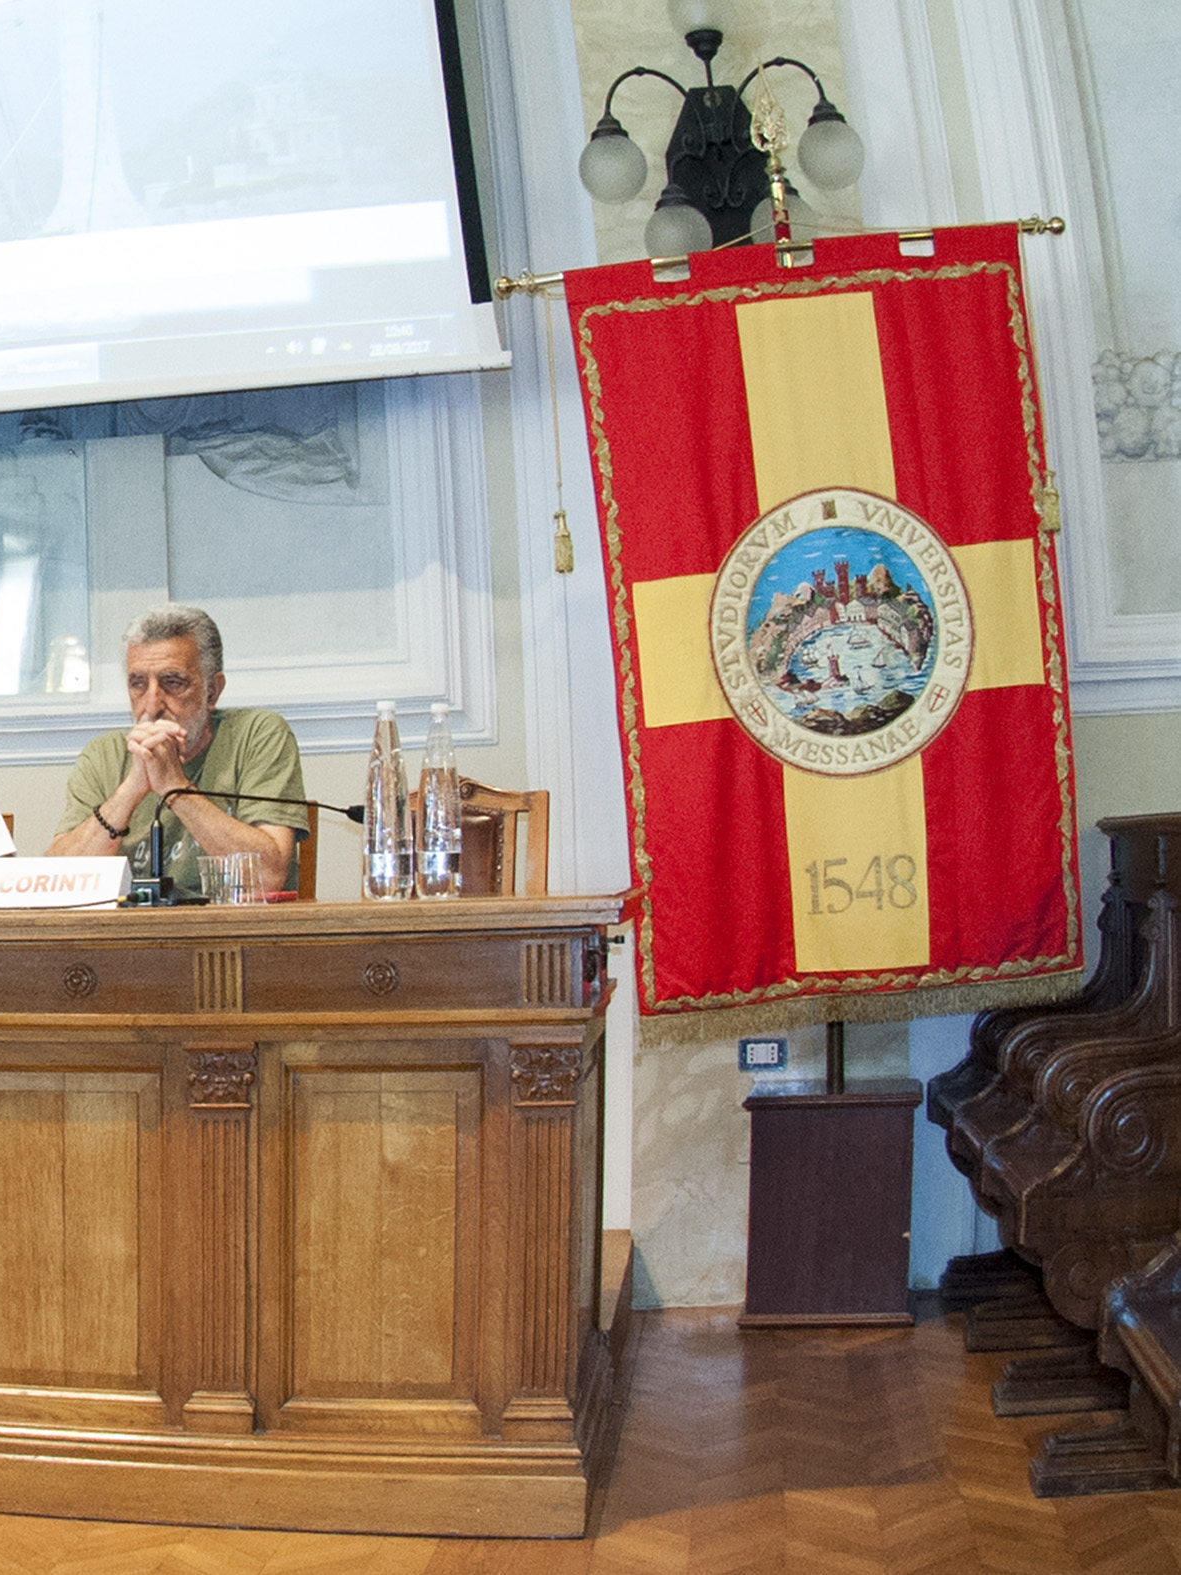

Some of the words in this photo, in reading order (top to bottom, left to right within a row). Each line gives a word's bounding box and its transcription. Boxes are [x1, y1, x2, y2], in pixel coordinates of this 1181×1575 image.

[858, 500, 965, 671] VNIVERSITAS
[777, 718, 921, 766] MESSANAE
[804, 854, 917, 916] 1548
